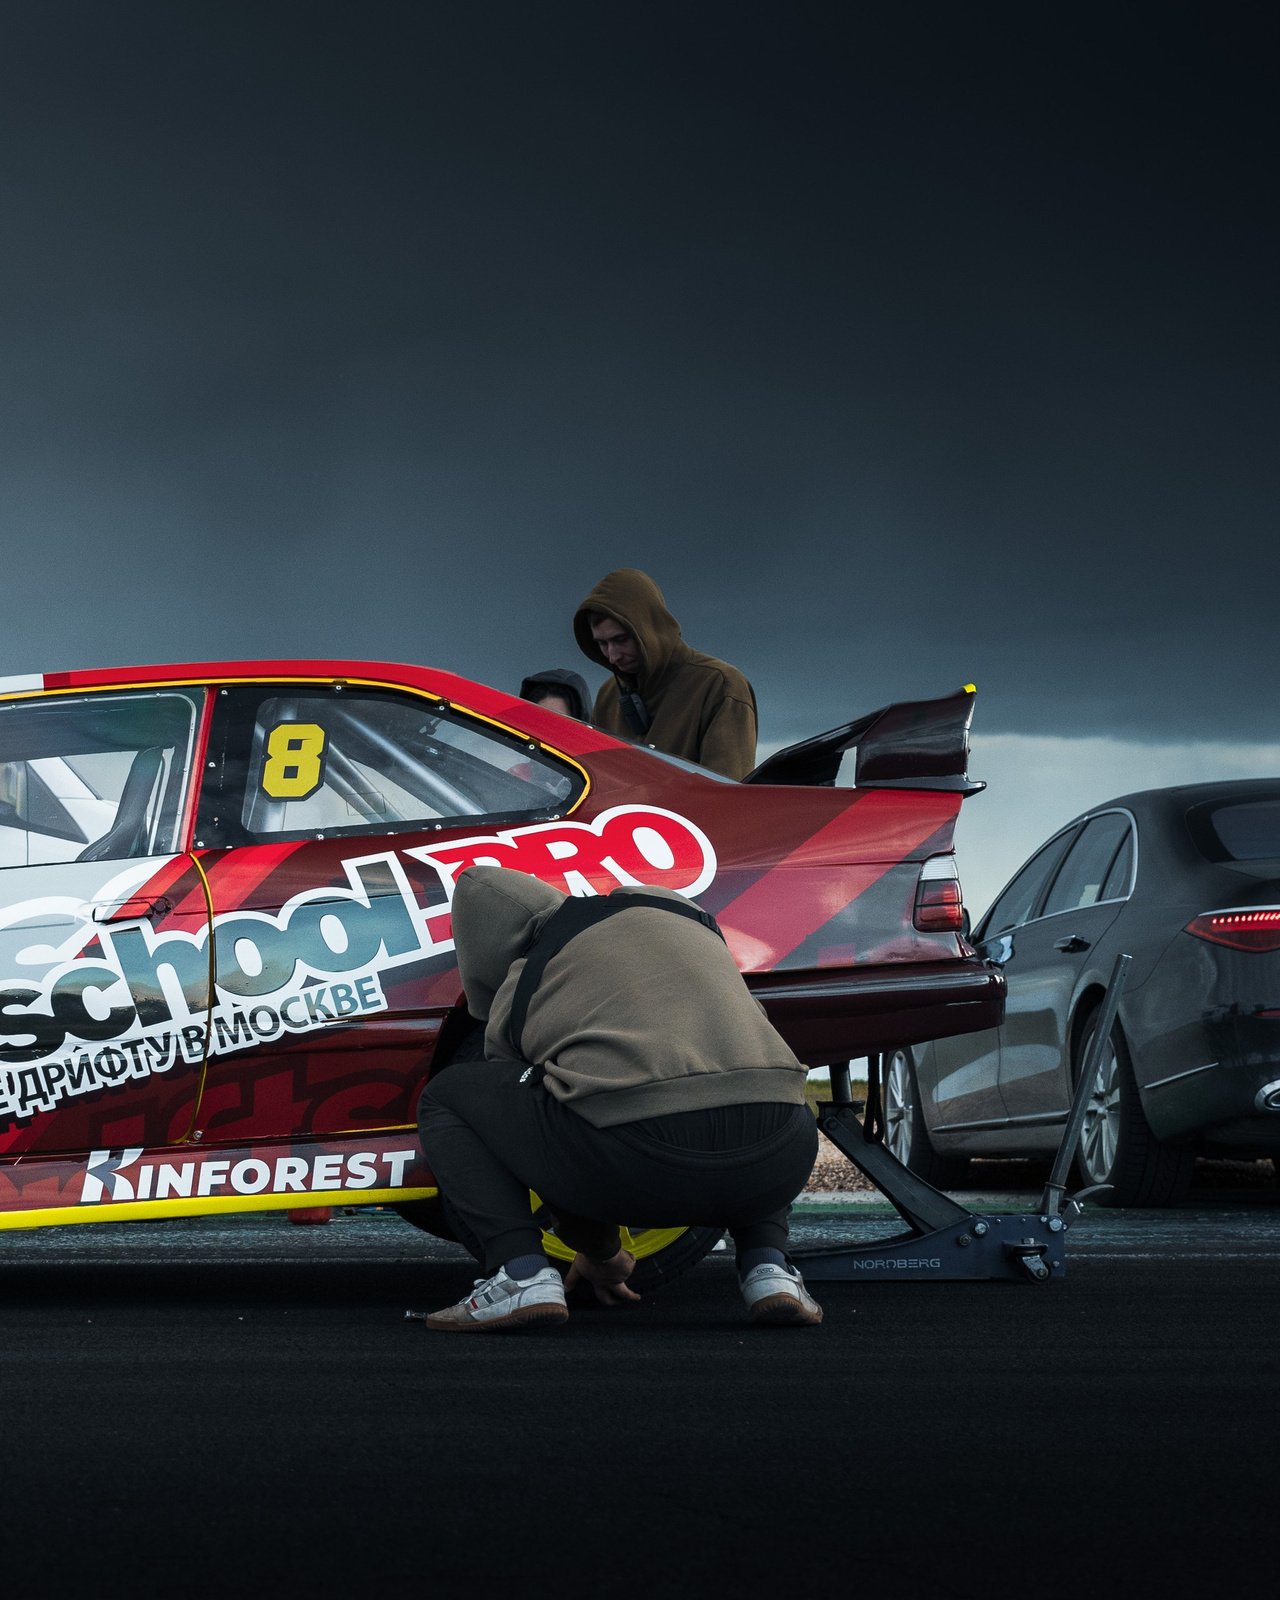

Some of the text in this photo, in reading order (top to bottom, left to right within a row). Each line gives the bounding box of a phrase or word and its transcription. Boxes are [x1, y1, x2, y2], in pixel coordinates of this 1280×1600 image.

[261, 722, 326, 799] 8
[19, 1031, 173, 1104] ДРИФТУ
[181, 1025, 205, 1058] В
[217, 976, 382, 1049] МОСКВЕ
[80, 1148, 416, 1202] KINFOREST
[853, 1258, 941, 1270] NORDBERG
